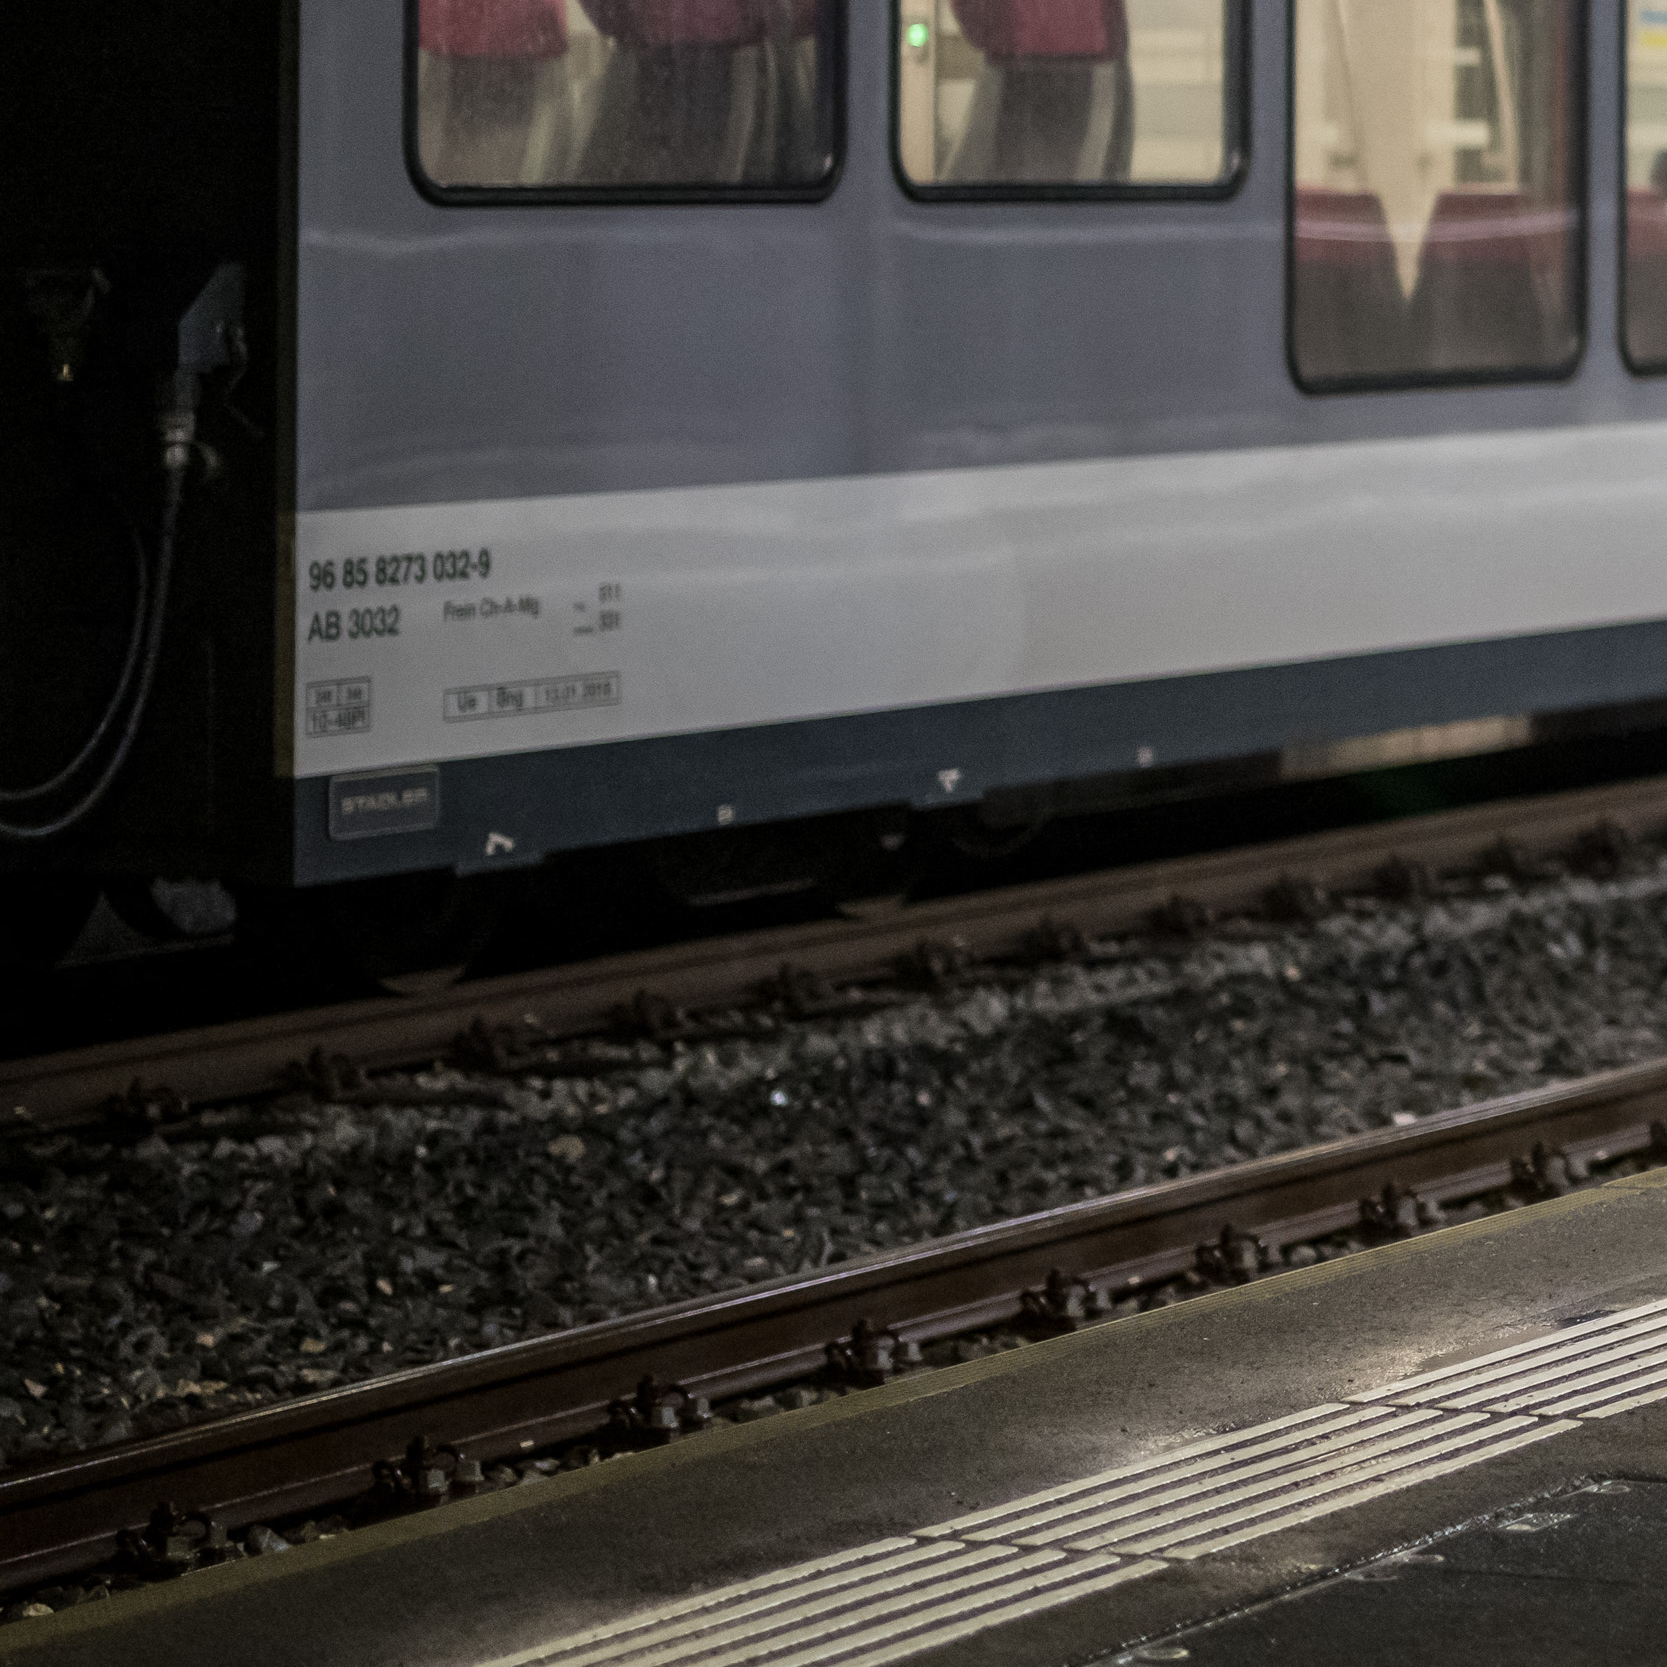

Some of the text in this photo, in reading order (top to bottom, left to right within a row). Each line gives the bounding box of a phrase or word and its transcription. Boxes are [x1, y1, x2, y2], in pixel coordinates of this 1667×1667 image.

[308, 547, 491, 591] 96 85 8273 032-9
[308, 604, 400, 643] AB 3032
